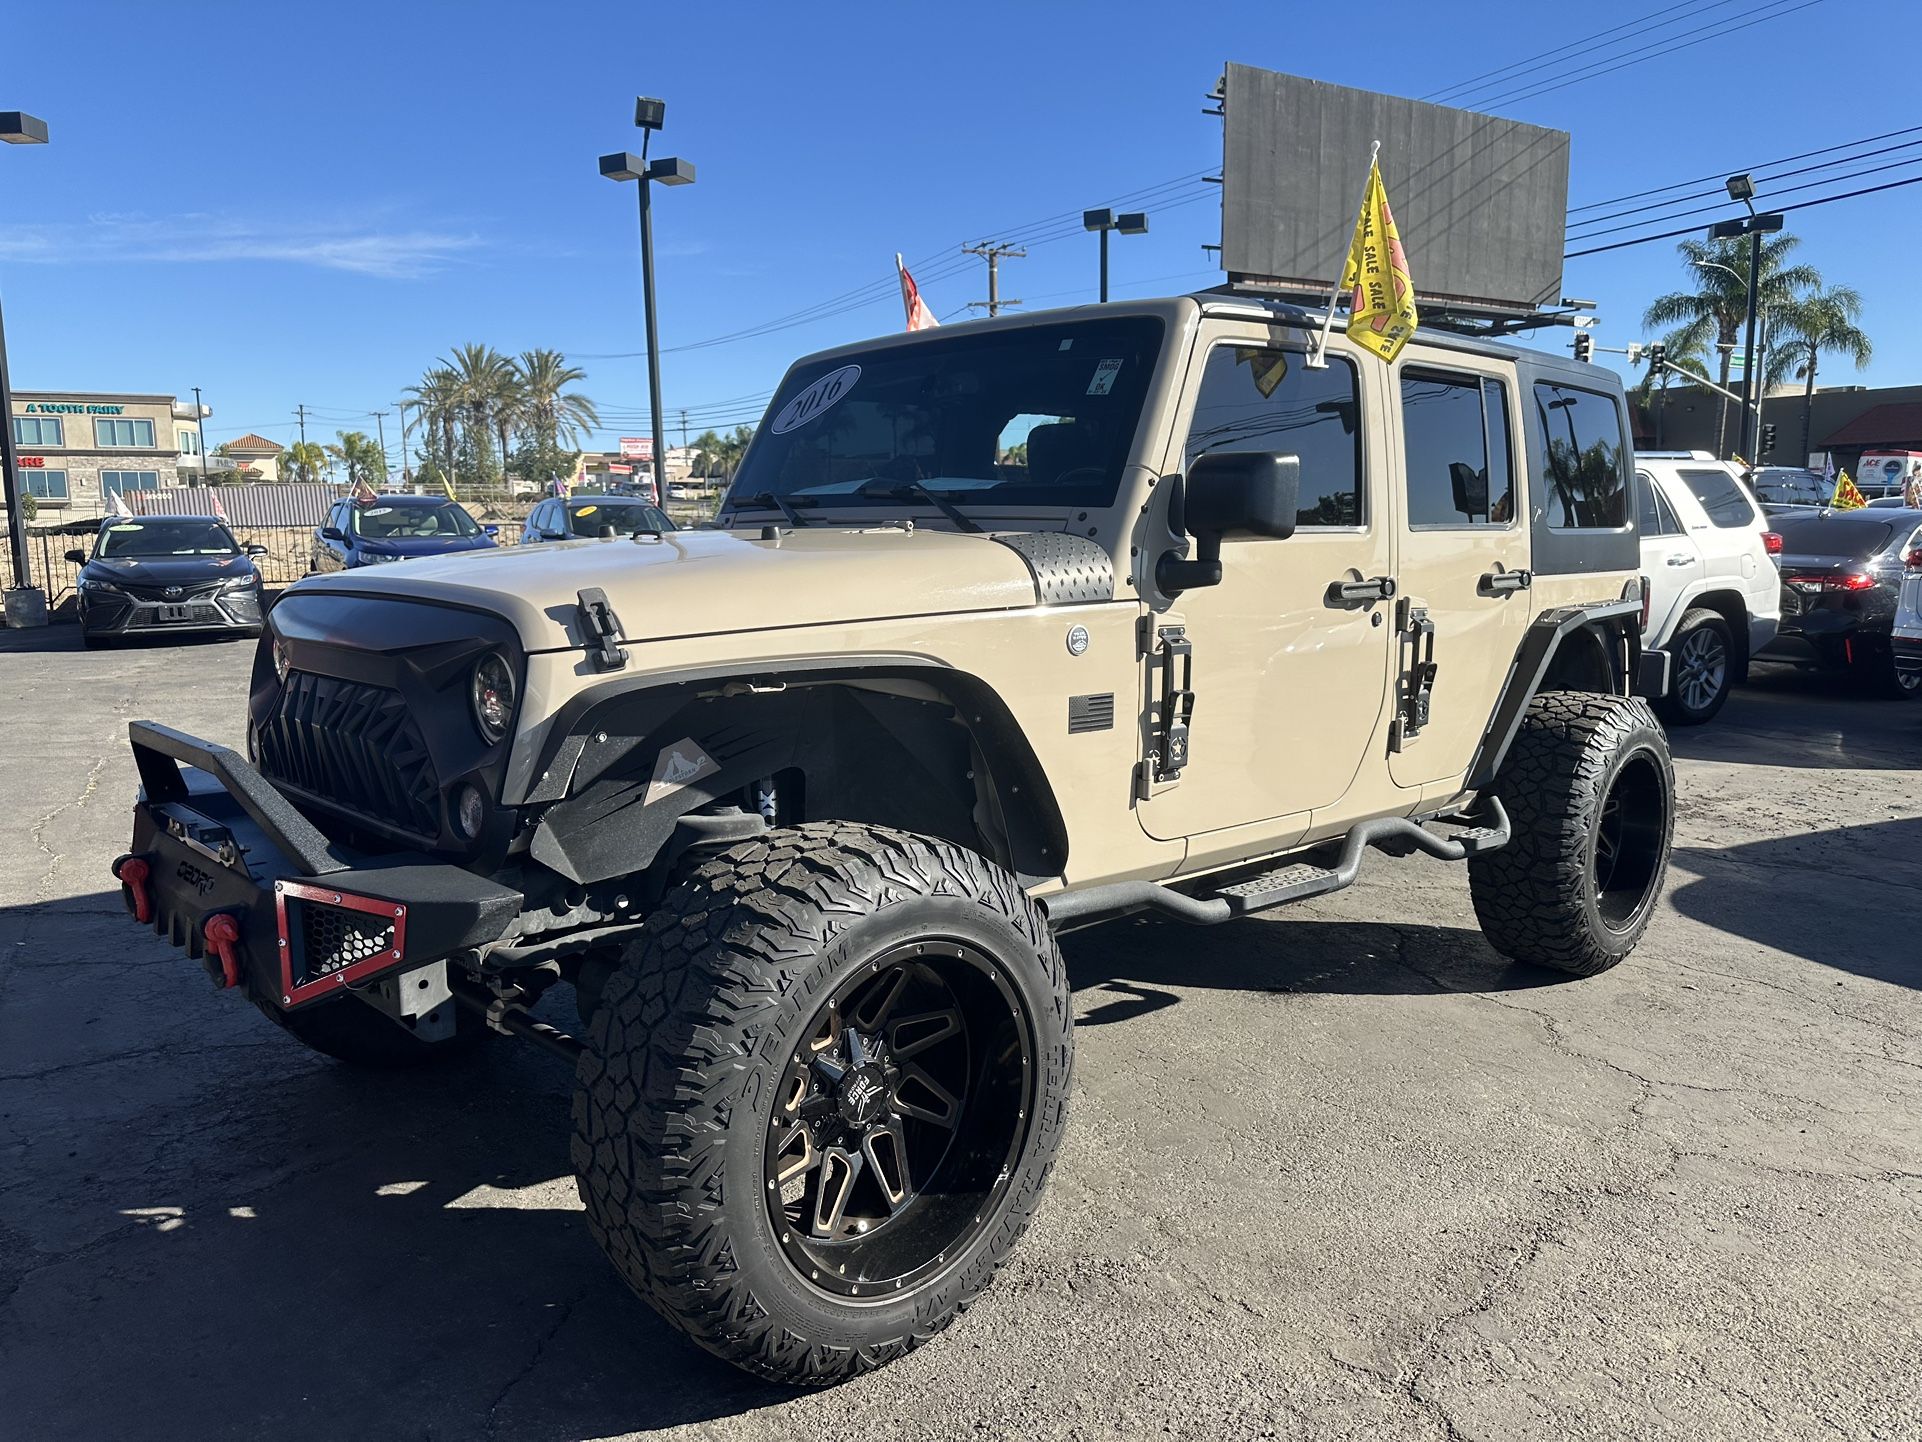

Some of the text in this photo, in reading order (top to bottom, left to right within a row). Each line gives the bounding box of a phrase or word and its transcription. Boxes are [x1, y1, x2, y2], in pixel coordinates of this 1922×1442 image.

[1364, 245, 1380, 274] SALE
[1369, 281, 1386, 310] SALE
[26, 403, 125, 415] A TOOTH FAIRY
[784, 370, 848, 428] 2016
[17, 457, 45, 467] ARE
[1863, 459, 1881, 467] ACE
[741, 939, 852, 1113] DELIUM
[848, 1075, 870, 1106] FORCE
